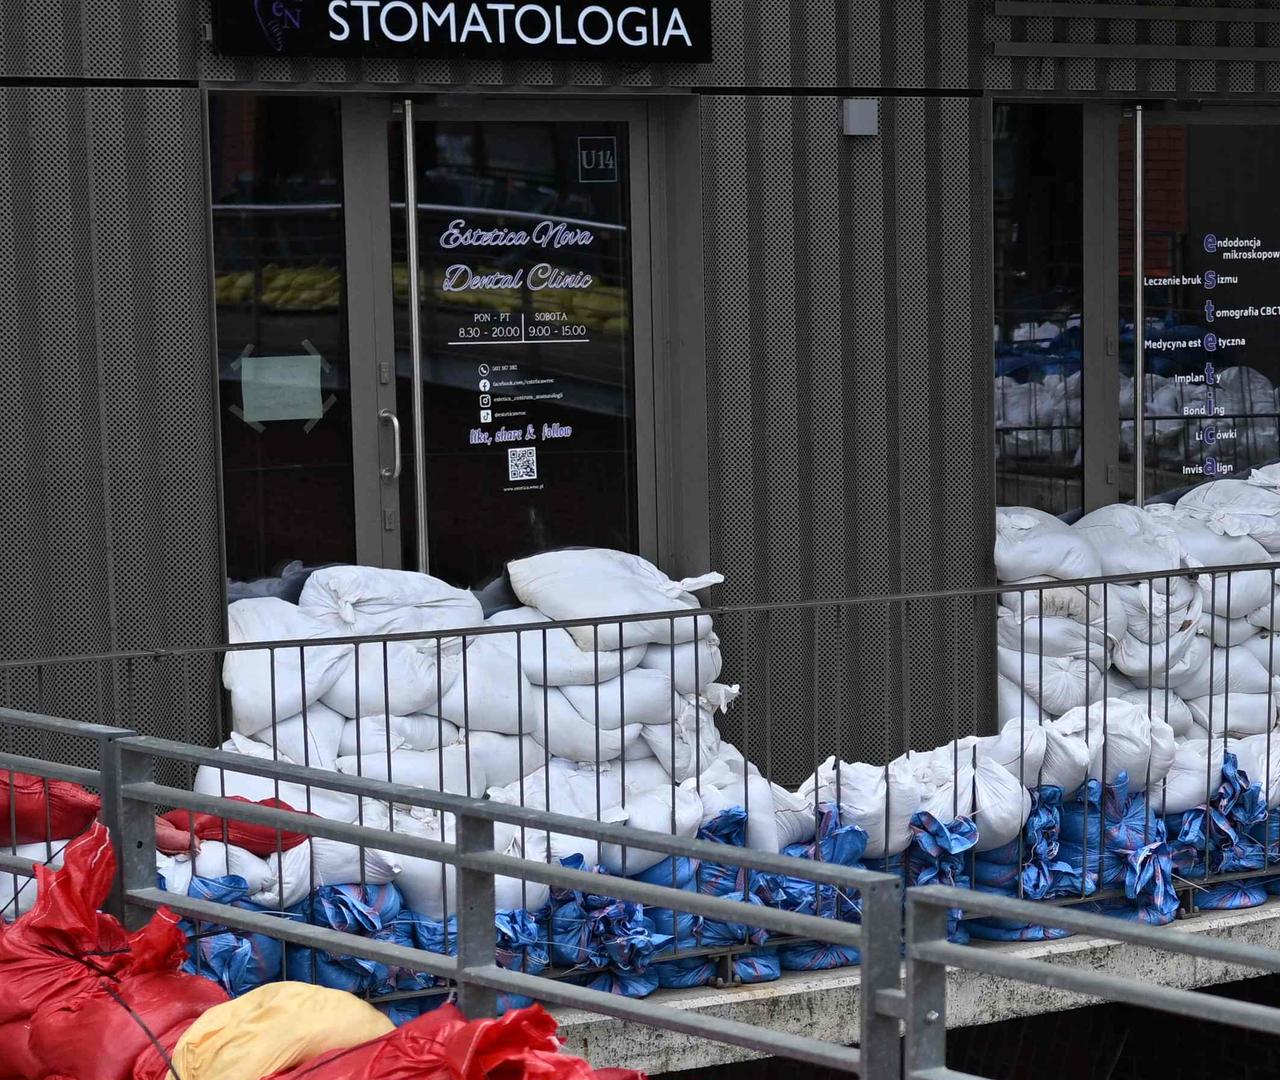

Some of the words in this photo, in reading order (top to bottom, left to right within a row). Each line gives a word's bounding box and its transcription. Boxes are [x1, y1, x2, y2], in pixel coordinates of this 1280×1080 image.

[328, 0, 693, 47] STOMATOLOGIA
[580, 150, 616, 169] U14
[439, 219, 530, 249] Estetica
[532, 220, 594, 248] Nova
[1203, 233, 1261, 253] endodoncja
[442, 263, 524, 292] Dental
[526, 262, 593, 291] Clinic
[1143, 275, 1181, 286] Leczenie
[473, 313, 491, 322] PON
[500, 313, 511, 322] PT
[534, 312, 568, 321] SOBOTA
[458, 327, 480, 338] 8.30
[491, 326, 520, 338] 20.00
[528, 325, 551, 337] 9.00
[561, 324, 586, 336] 15.00
[1143, 338, 1187, 350] Medycyna
[469, 427, 493, 446] like,
[494, 426, 523, 443] share
[524, 423, 537, 441] &
[541, 422, 573, 441] follow
